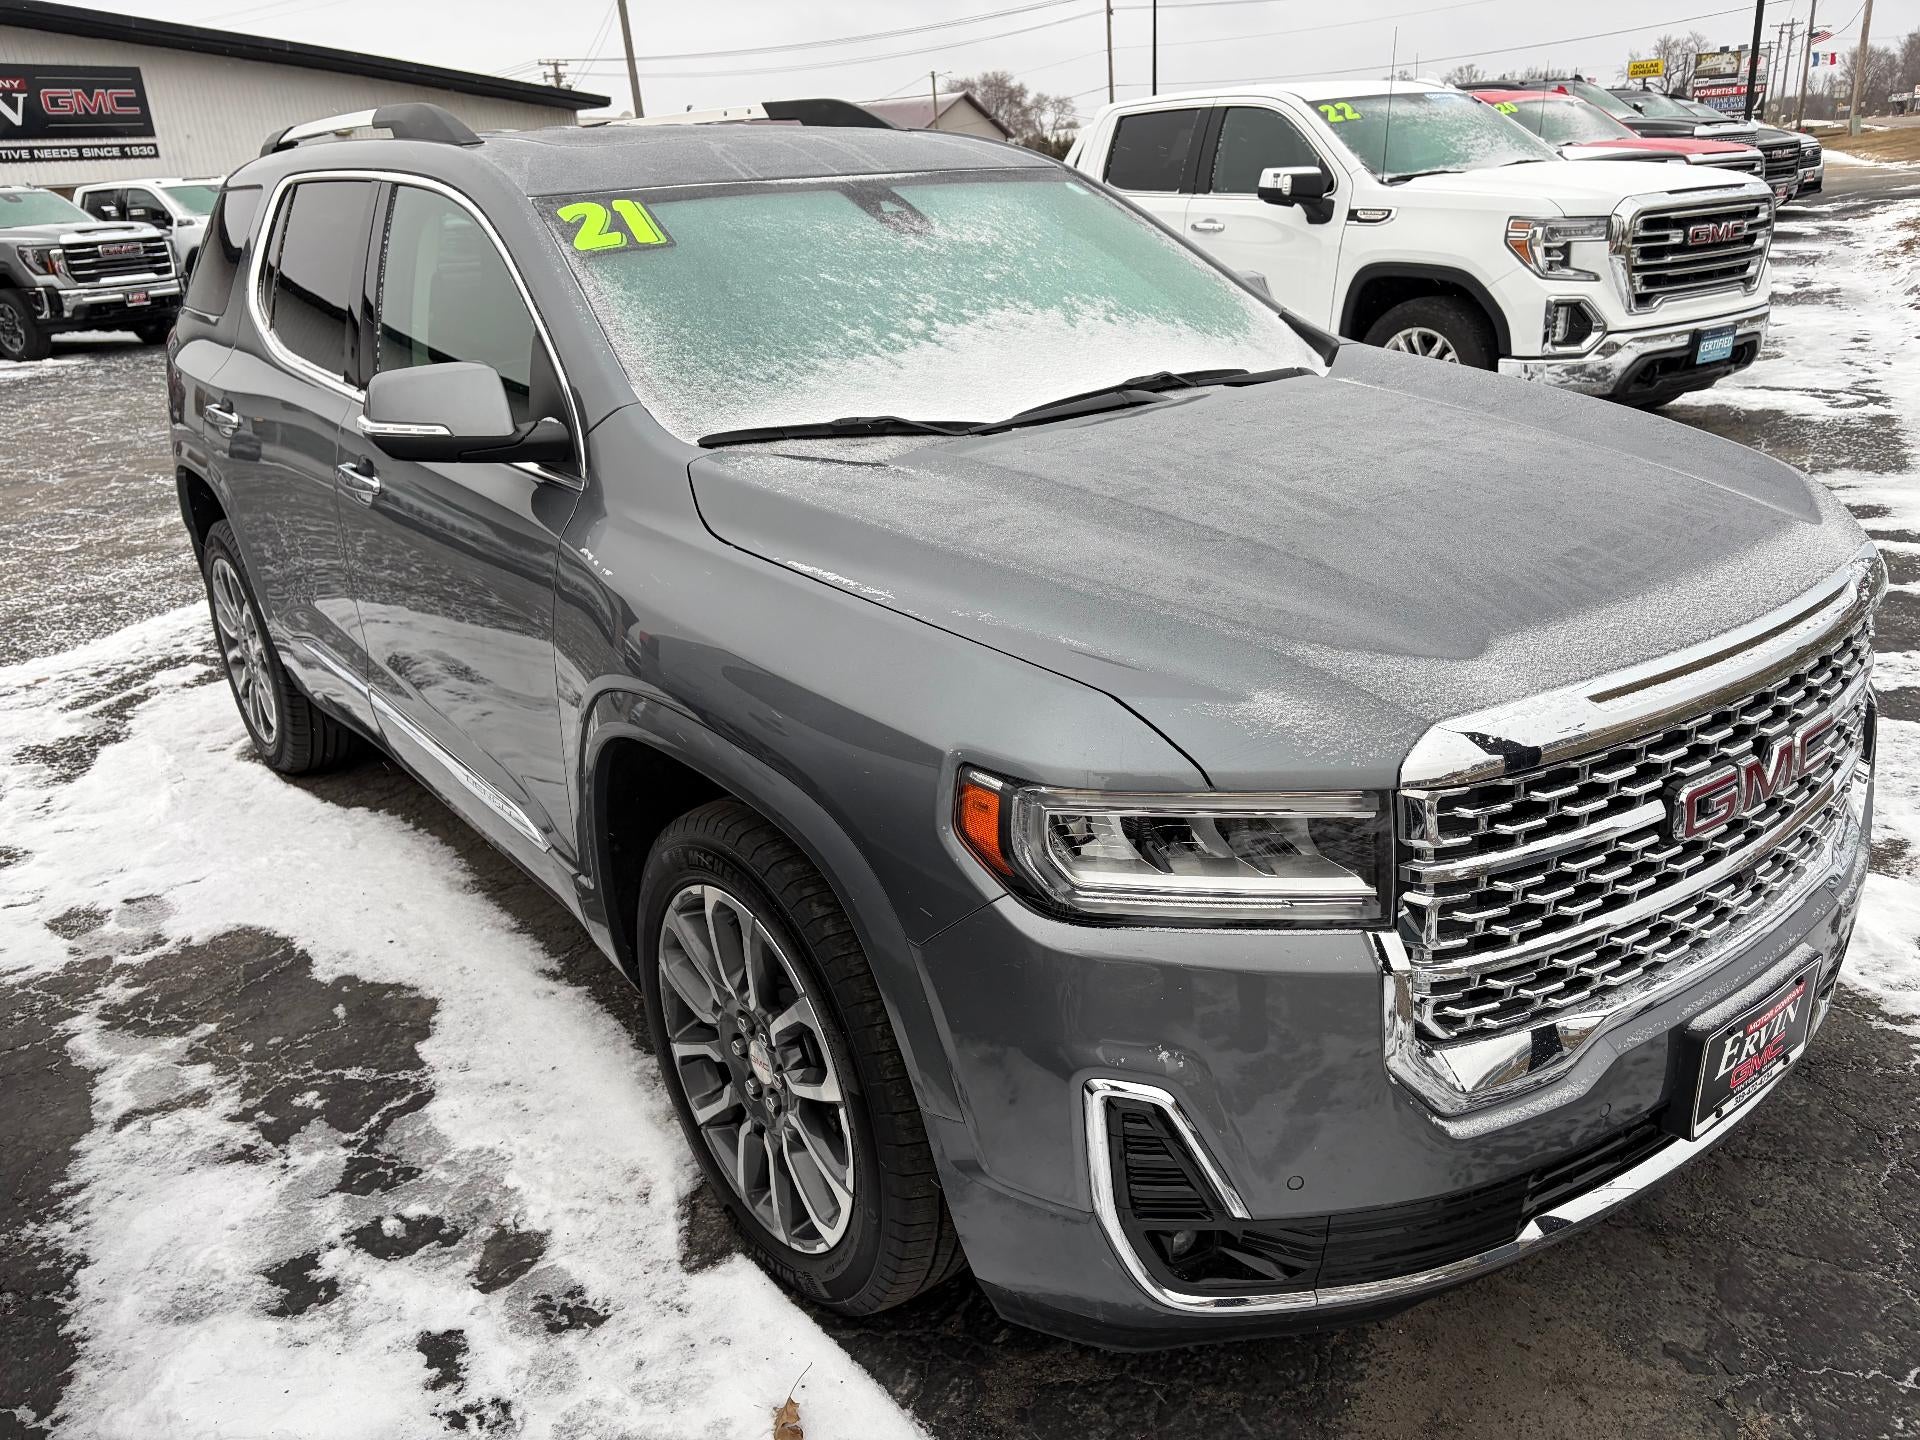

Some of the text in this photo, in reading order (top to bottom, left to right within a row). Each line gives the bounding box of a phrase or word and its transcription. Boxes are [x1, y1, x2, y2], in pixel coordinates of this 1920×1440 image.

[40, 88, 141, 115] GMC
[1694, 86, 1738, 97] ADVERTISE
[1319, 102, 1362, 123] 22
[1494, 102, 1519, 115] 20
[34, 148, 80, 159] NEEDS
[82, 147, 121, 158] SINCE
[557, 199, 667, 251] 21
[1689, 220, 1746, 245] GMC
[1700, 336, 1733, 353] CERTIFIED
[1674, 711, 1834, 841] GMC
[1714, 994, 1804, 1082] ERVIN
[1730, 1031, 1786, 1089] GMC
